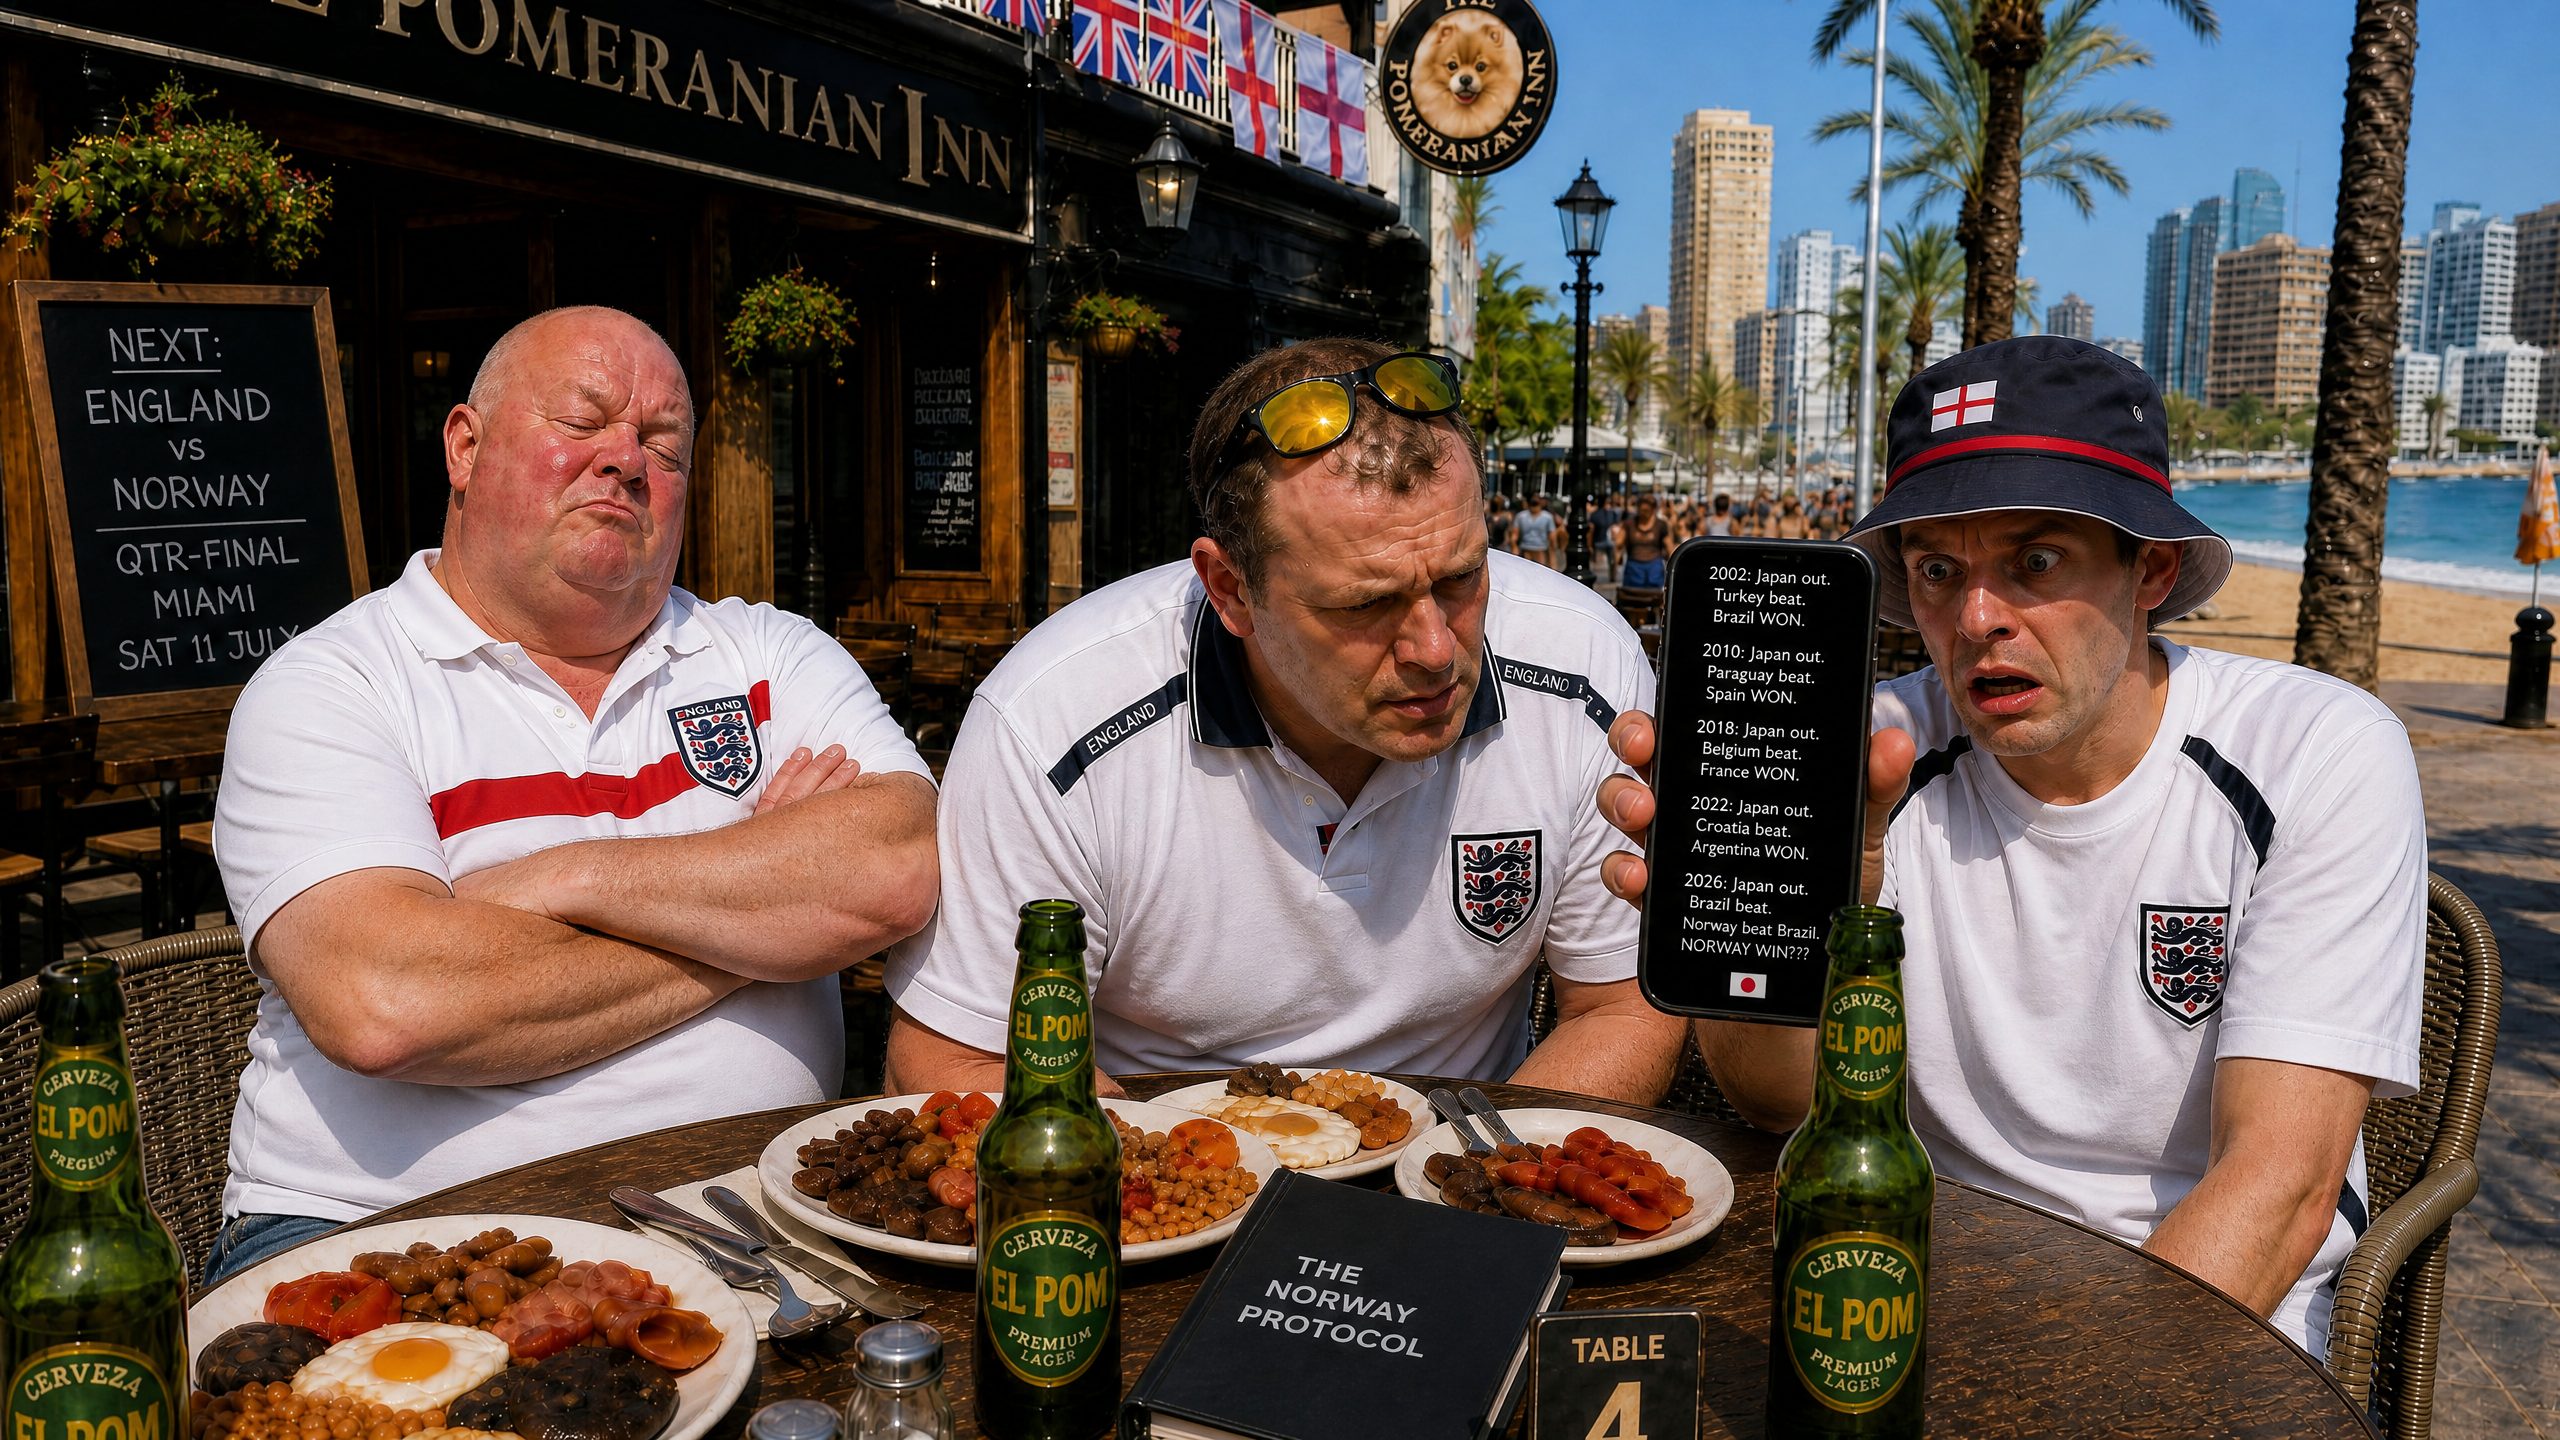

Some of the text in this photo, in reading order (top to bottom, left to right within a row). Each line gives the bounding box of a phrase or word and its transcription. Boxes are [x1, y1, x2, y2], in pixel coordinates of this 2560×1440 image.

[899, 83, 1014, 193] INN
[108, 327, 222, 362] NEXT:
[85, 388, 271, 425] ENGLAND
[113, 473, 271, 512] NORWAY
[116, 536, 300, 576] QTR-FINAL
[1709, 566, 1831, 587] 2002: Japan out.
[153, 584, 256, 620] MIAMI
[1714, 587, 1806, 607] Turkey beat.
[1713, 609, 1805, 627] Brazil WON.
[118, 624, 299, 671] SAT 11 JULY
[1702, 643, 1825, 664] 2010: Japan out.
[1503, 664, 1570, 693] ENGLAND
[1707, 664, 1815, 685] Paraguay beat.
[1705, 685, 1797, 704] Spain WON.
[1085, 702, 1156, 755] ENGLAND
[1697, 719, 1819, 740] 2018: Japan out.
[1702, 741, 1802, 760] Belgium beat.
[1700, 762, 1800, 782] France WON.
[1691, 795, 1813, 818] 2022: Japan out.
[1695, 818, 1792, 838] Croatia beat.
[1691, 839, 1809, 861] Argentina WON.
[1684, 872, 1809, 896] 2026: Japan out.
[1689, 895, 1772, 915] Brazil beat.
[1682, 916, 1820, 940] Norway beat Brazil.
[1681, 937, 1810, 961] NORWAY WIN???
[1021, 984, 1082, 1007] CERVEZA
[1832, 992, 1897, 1018] CERVEZA
[1015, 1010, 1087, 1042] EL POM
[1824, 1019, 1903, 1056] EL POM
[42, 1069, 119, 1097] CERVEZA
[37, 1099, 129, 1140] EL POM
[1003, 1228, 1099, 1260] CERVEZA
[1297, 1255, 1364, 1286] THE
[1807, 1250, 1908, 1285] CERVEZA
[991, 1265, 1108, 1318] EL POM
[1264, 1279, 1419, 1325] NORWAY
[1793, 1285, 1916, 1342] EL POM
[1007, 1325, 1092, 1351] PREMIUM
[1237, 1304, 1425, 1359] PROTOCOL
[1020, 1349, 1076, 1367] LAGER
[1571, 1333, 1666, 1365] TABLE
[1810, 1347, 1899, 1376] PREMIUM
[24, 1362, 143, 1401] CERVEZA
[1823, 1373, 1881, 1393] LAGER
[1583, 1381, 1647, 1440] 4
